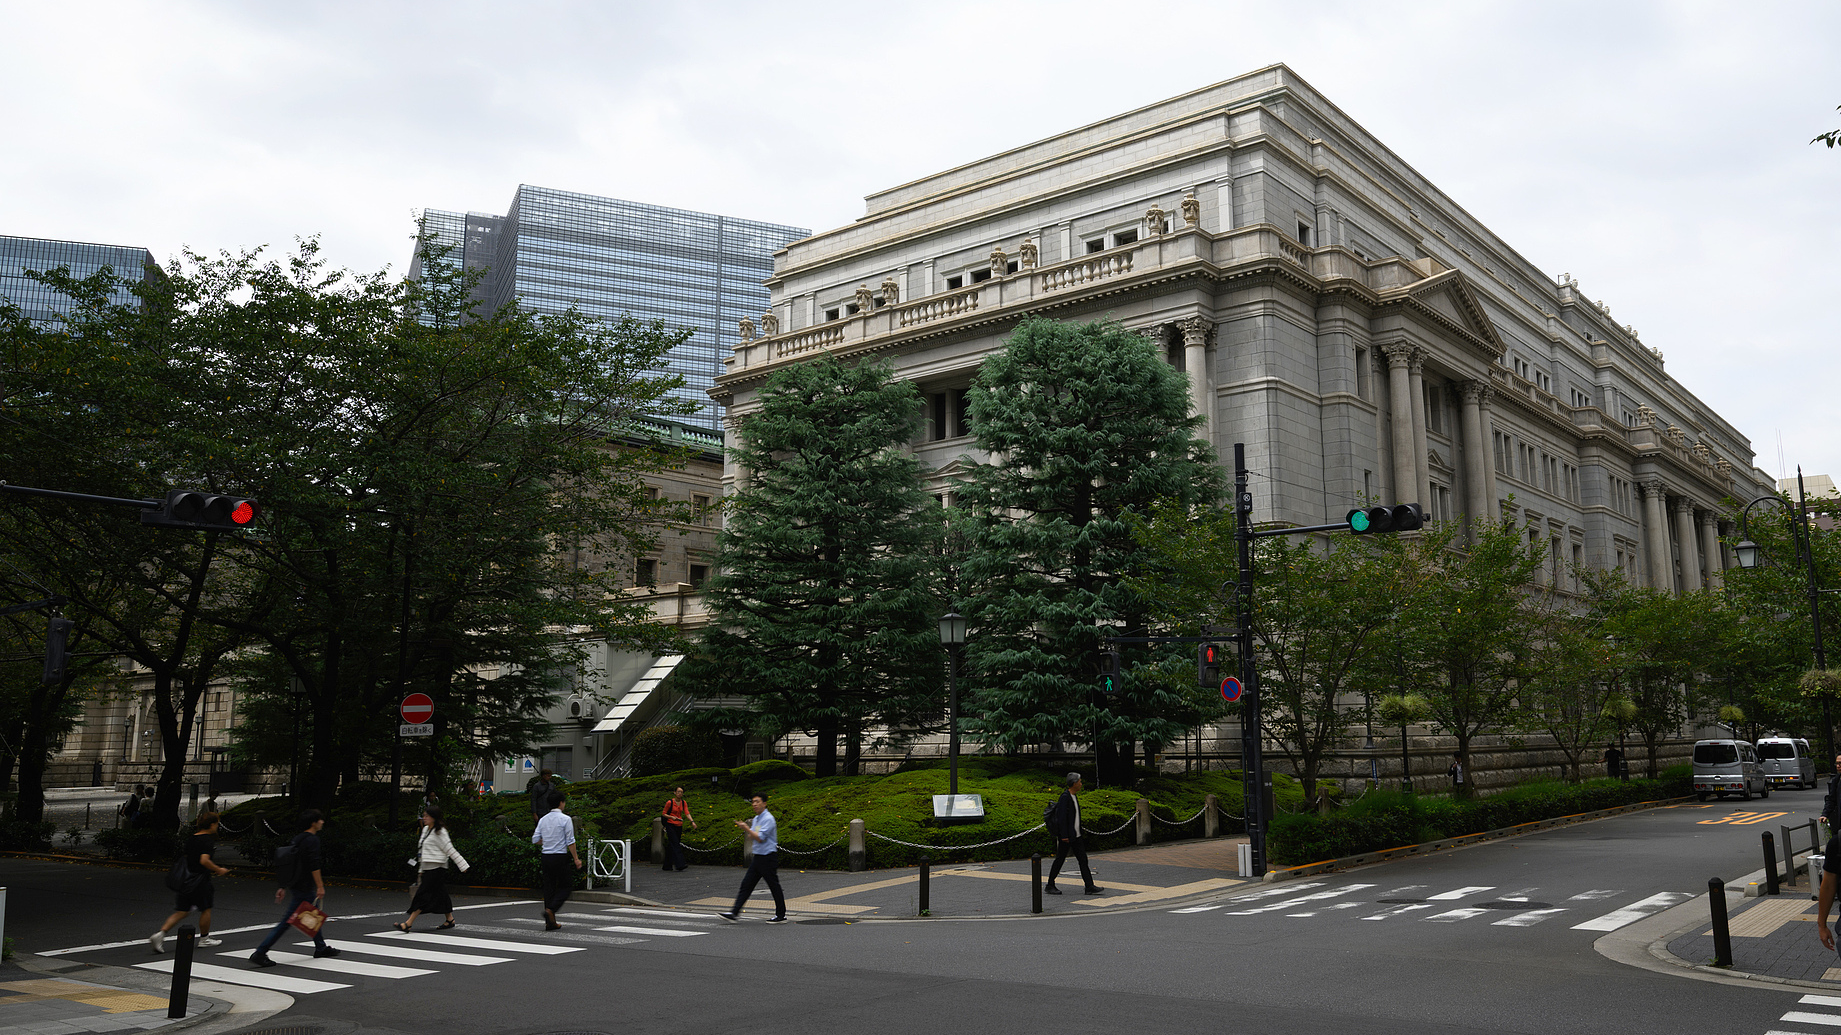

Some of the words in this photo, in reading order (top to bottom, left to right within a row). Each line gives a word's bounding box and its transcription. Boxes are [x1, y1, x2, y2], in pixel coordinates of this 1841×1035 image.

[401, 726, 432, 735] 自転車を除く
[1696, 811, 1788, 825] 30
